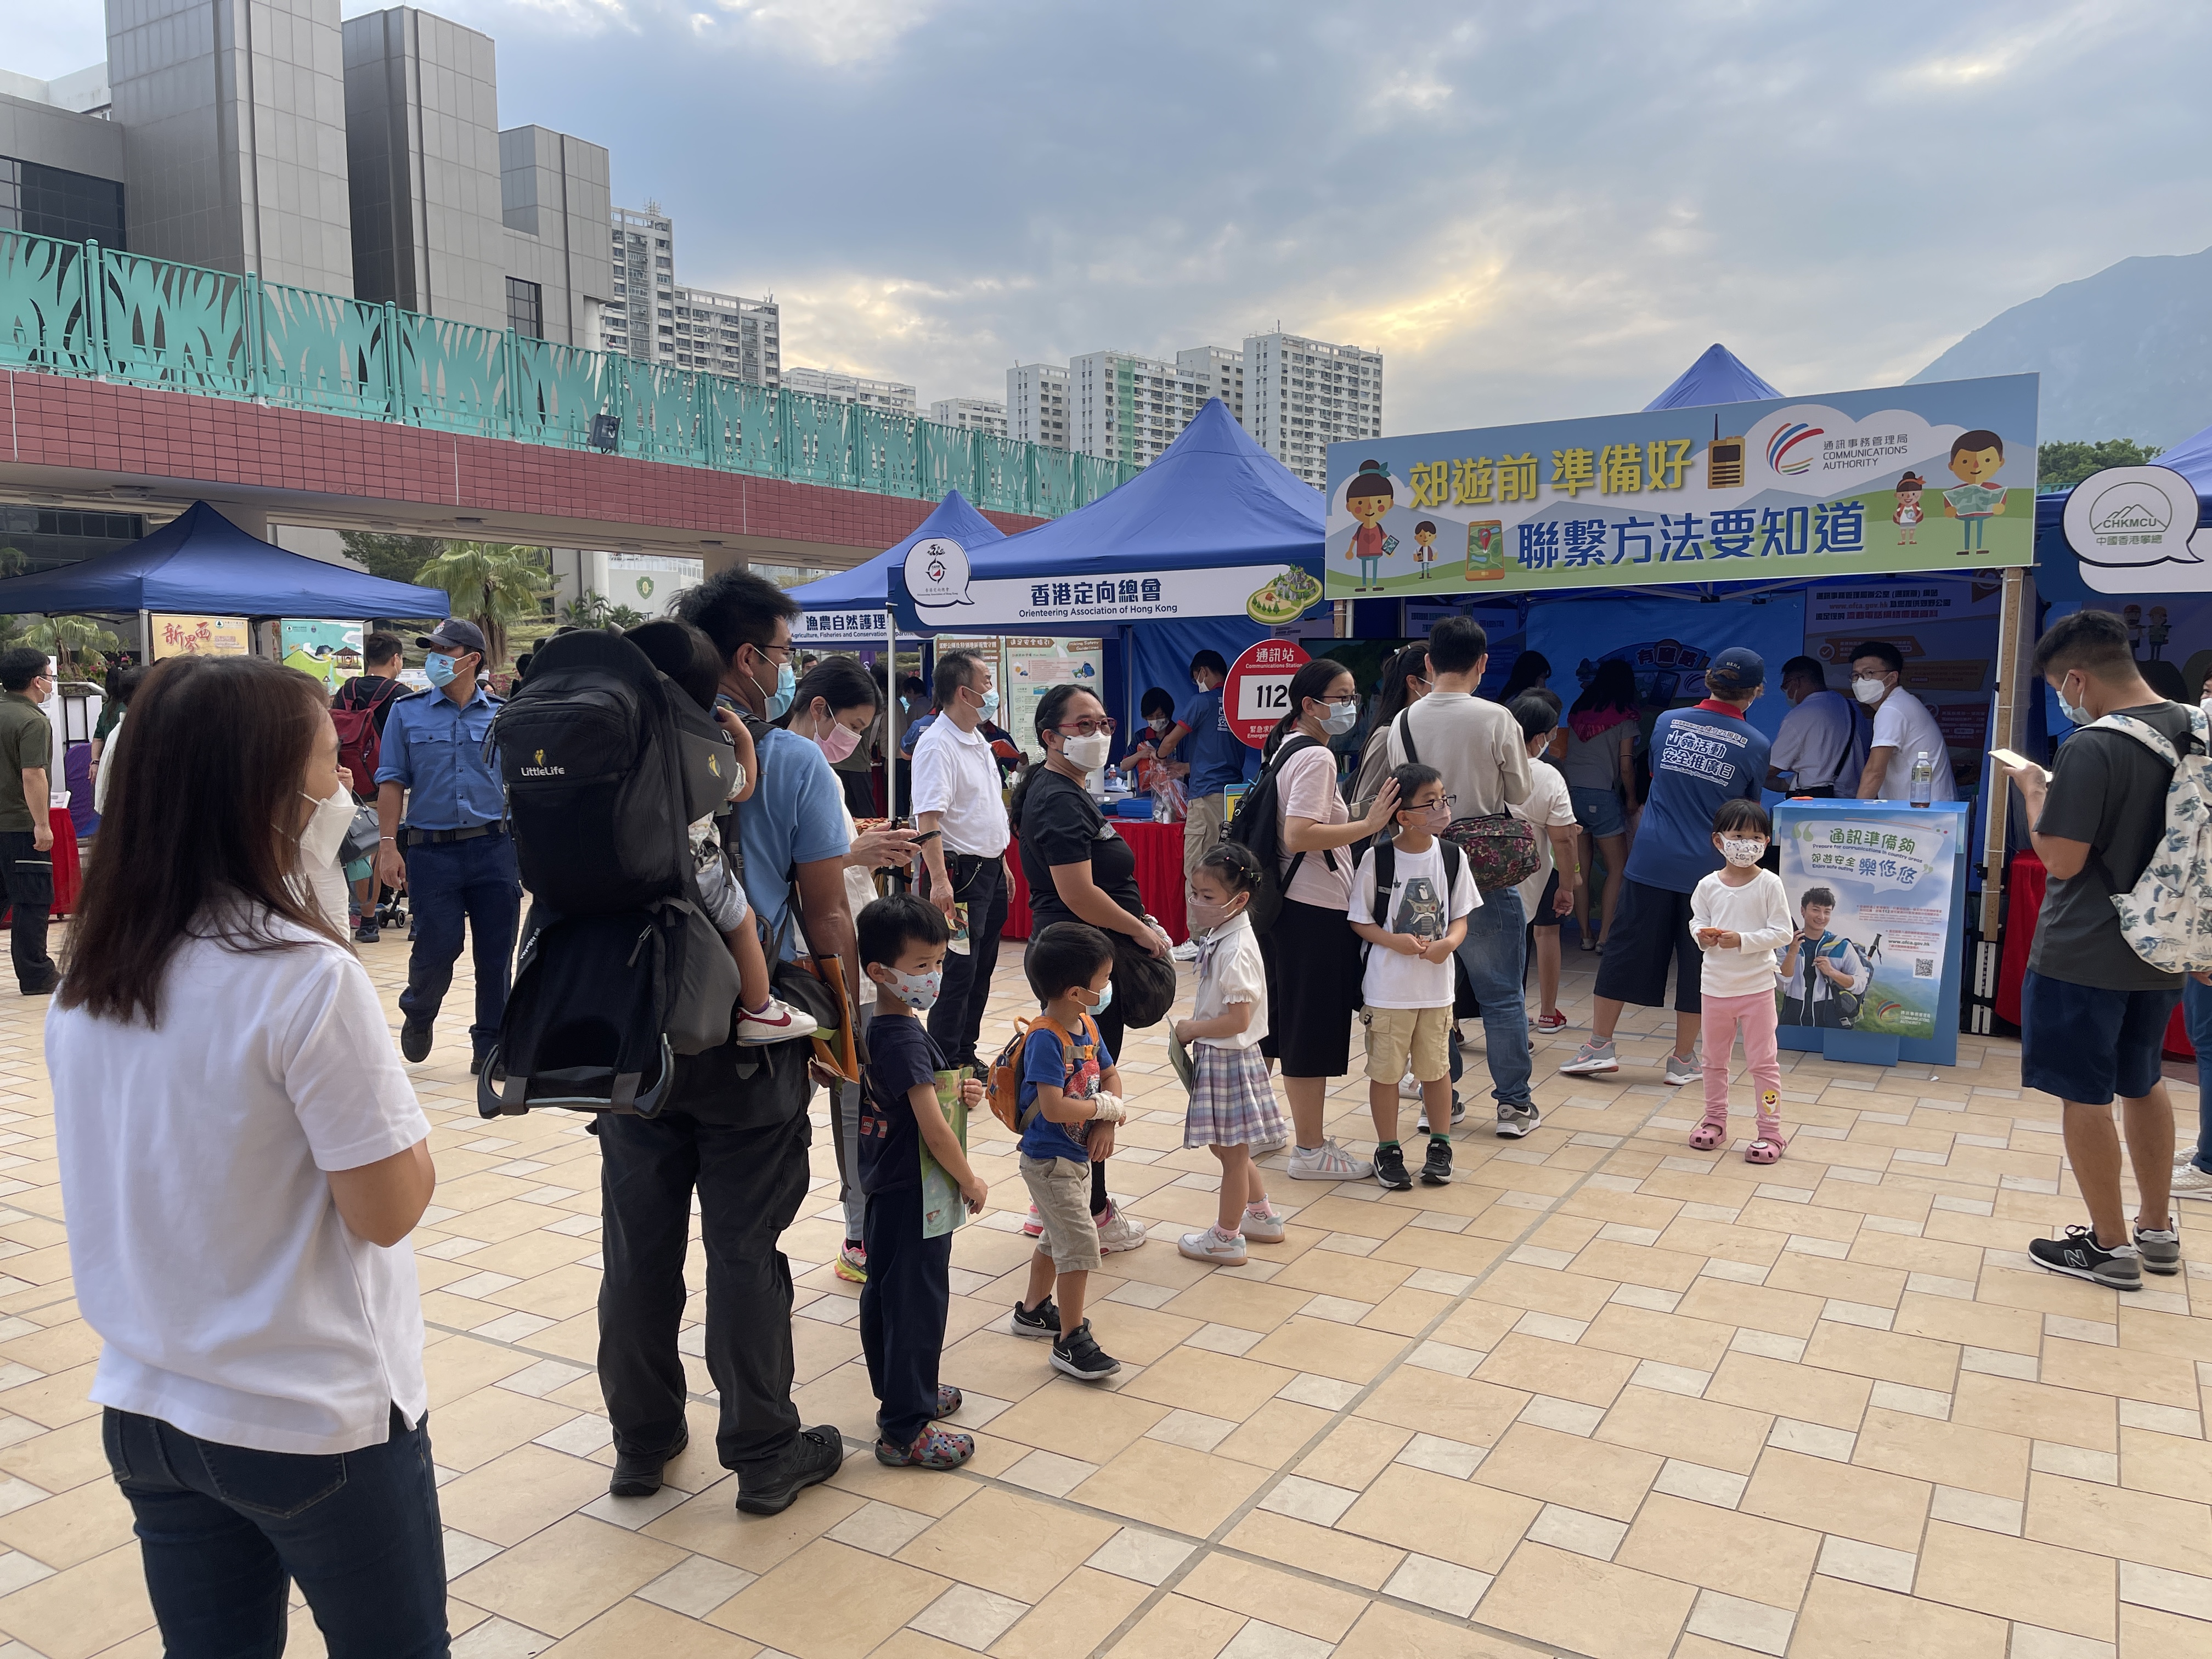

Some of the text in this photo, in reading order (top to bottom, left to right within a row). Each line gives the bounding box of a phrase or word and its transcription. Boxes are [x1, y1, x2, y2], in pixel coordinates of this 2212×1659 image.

[1823, 445, 1908, 460] COMMUNICATIONS
[1824, 434, 1908, 450] 通訊事務管理局
[1409, 439, 1692, 509] 郊遊前 準備好
[1823, 458, 1878, 470] AUTHORITY
[2102, 517, 2157, 528] CHKMCU
[1517, 501, 1865, 569] 聯繫方法要知道
[1031, 578, 1162, 607] 香港定向總會
[806, 614, 887, 631] 漁農自然護理
[1019, 604, 1177, 617] Orienteering Association of Hong Kong
[161, 621, 211, 653] 新界西
[1256, 648, 1295, 663] 通訊站
[1256, 684, 1288, 708] 112
[1666, 730, 1726, 759] 山嶺活動
[521, 766, 565, 776] LittleLife
[1660, 763, 1679, 772] Mountain
[1680, 767, 1694, 776] Safety
[1719, 779, 1729, 787] Day
[1661, 748, 1735, 780] 安全推廣日
[1830, 827, 1916, 855] 通訊準備夠
[1843, 845, 1881, 854] communications
[1888, 851, 1908, 860] country
[1812, 853, 1918, 884] 郊遊安全 樂悠悠
